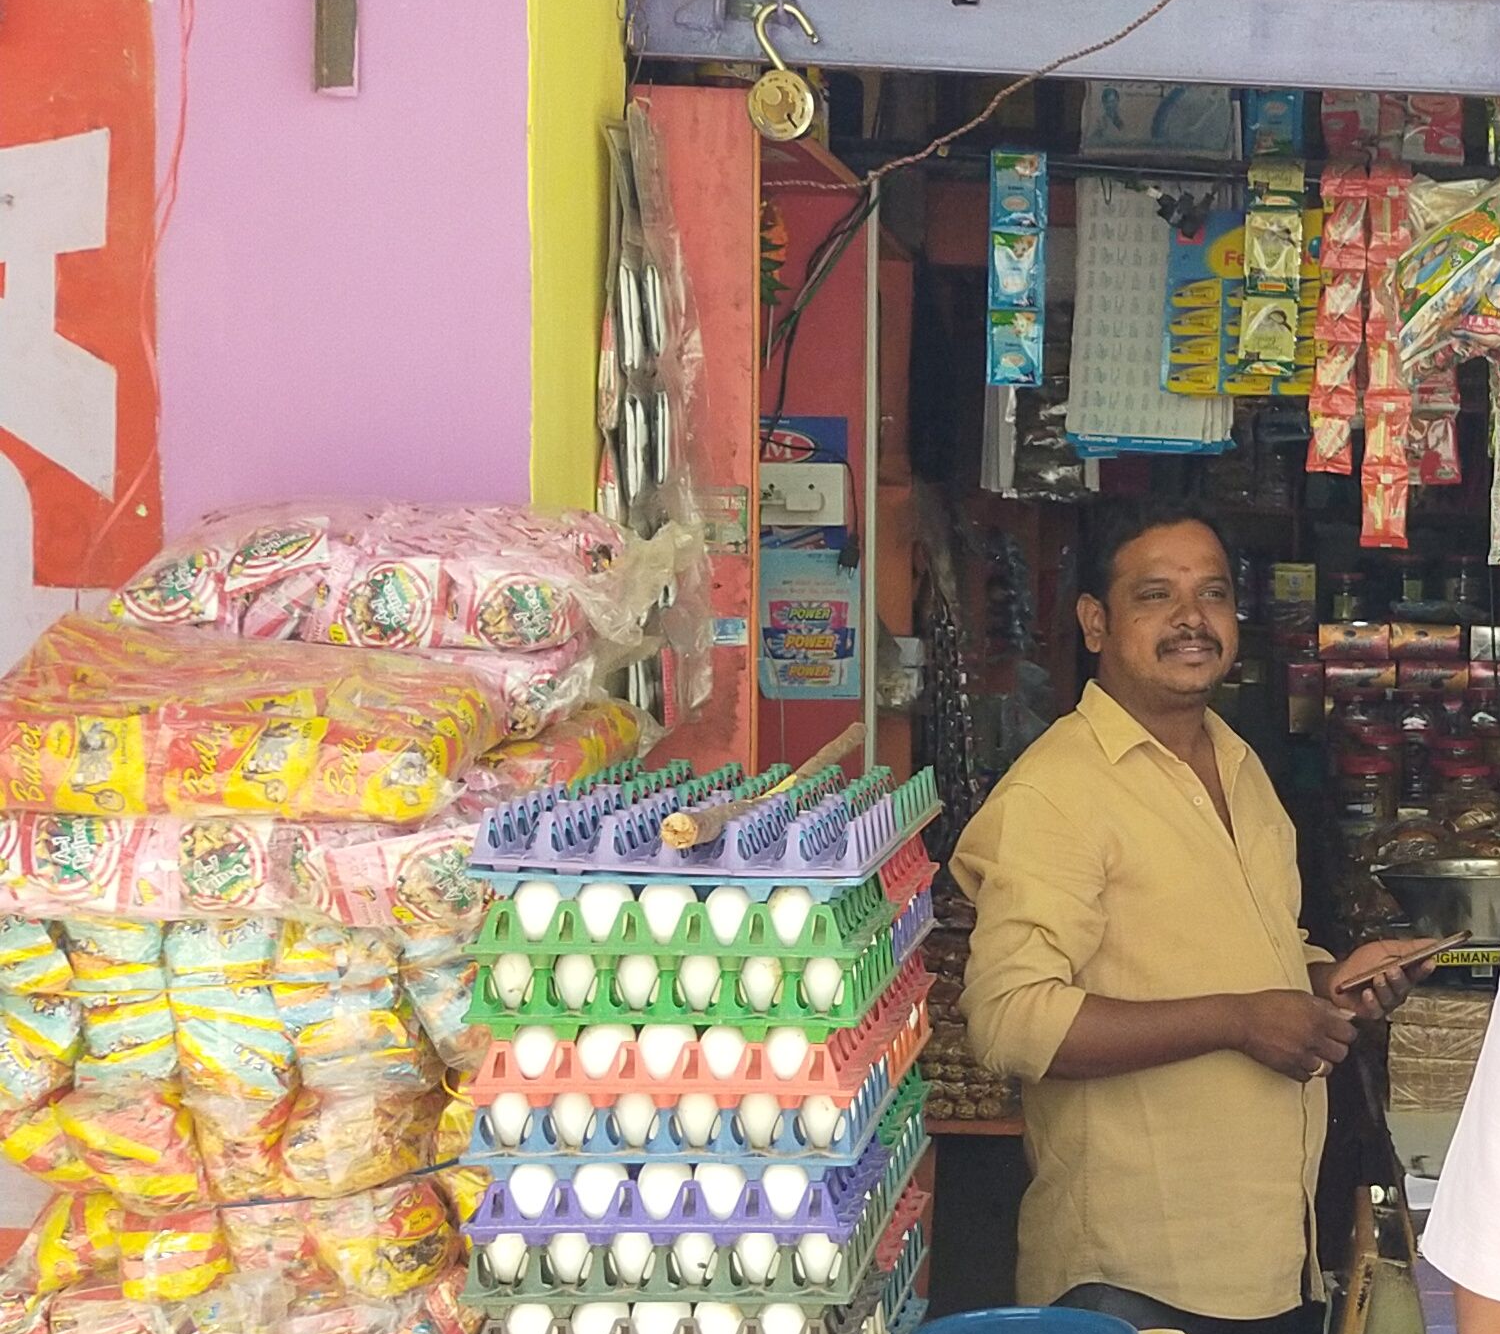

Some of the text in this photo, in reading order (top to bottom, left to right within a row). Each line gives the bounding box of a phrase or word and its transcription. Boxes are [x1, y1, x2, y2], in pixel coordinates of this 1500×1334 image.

[787, 608, 832, 621] POWER
[783, 634, 836, 649] POWER
[787, 665, 831, 678] POWER
